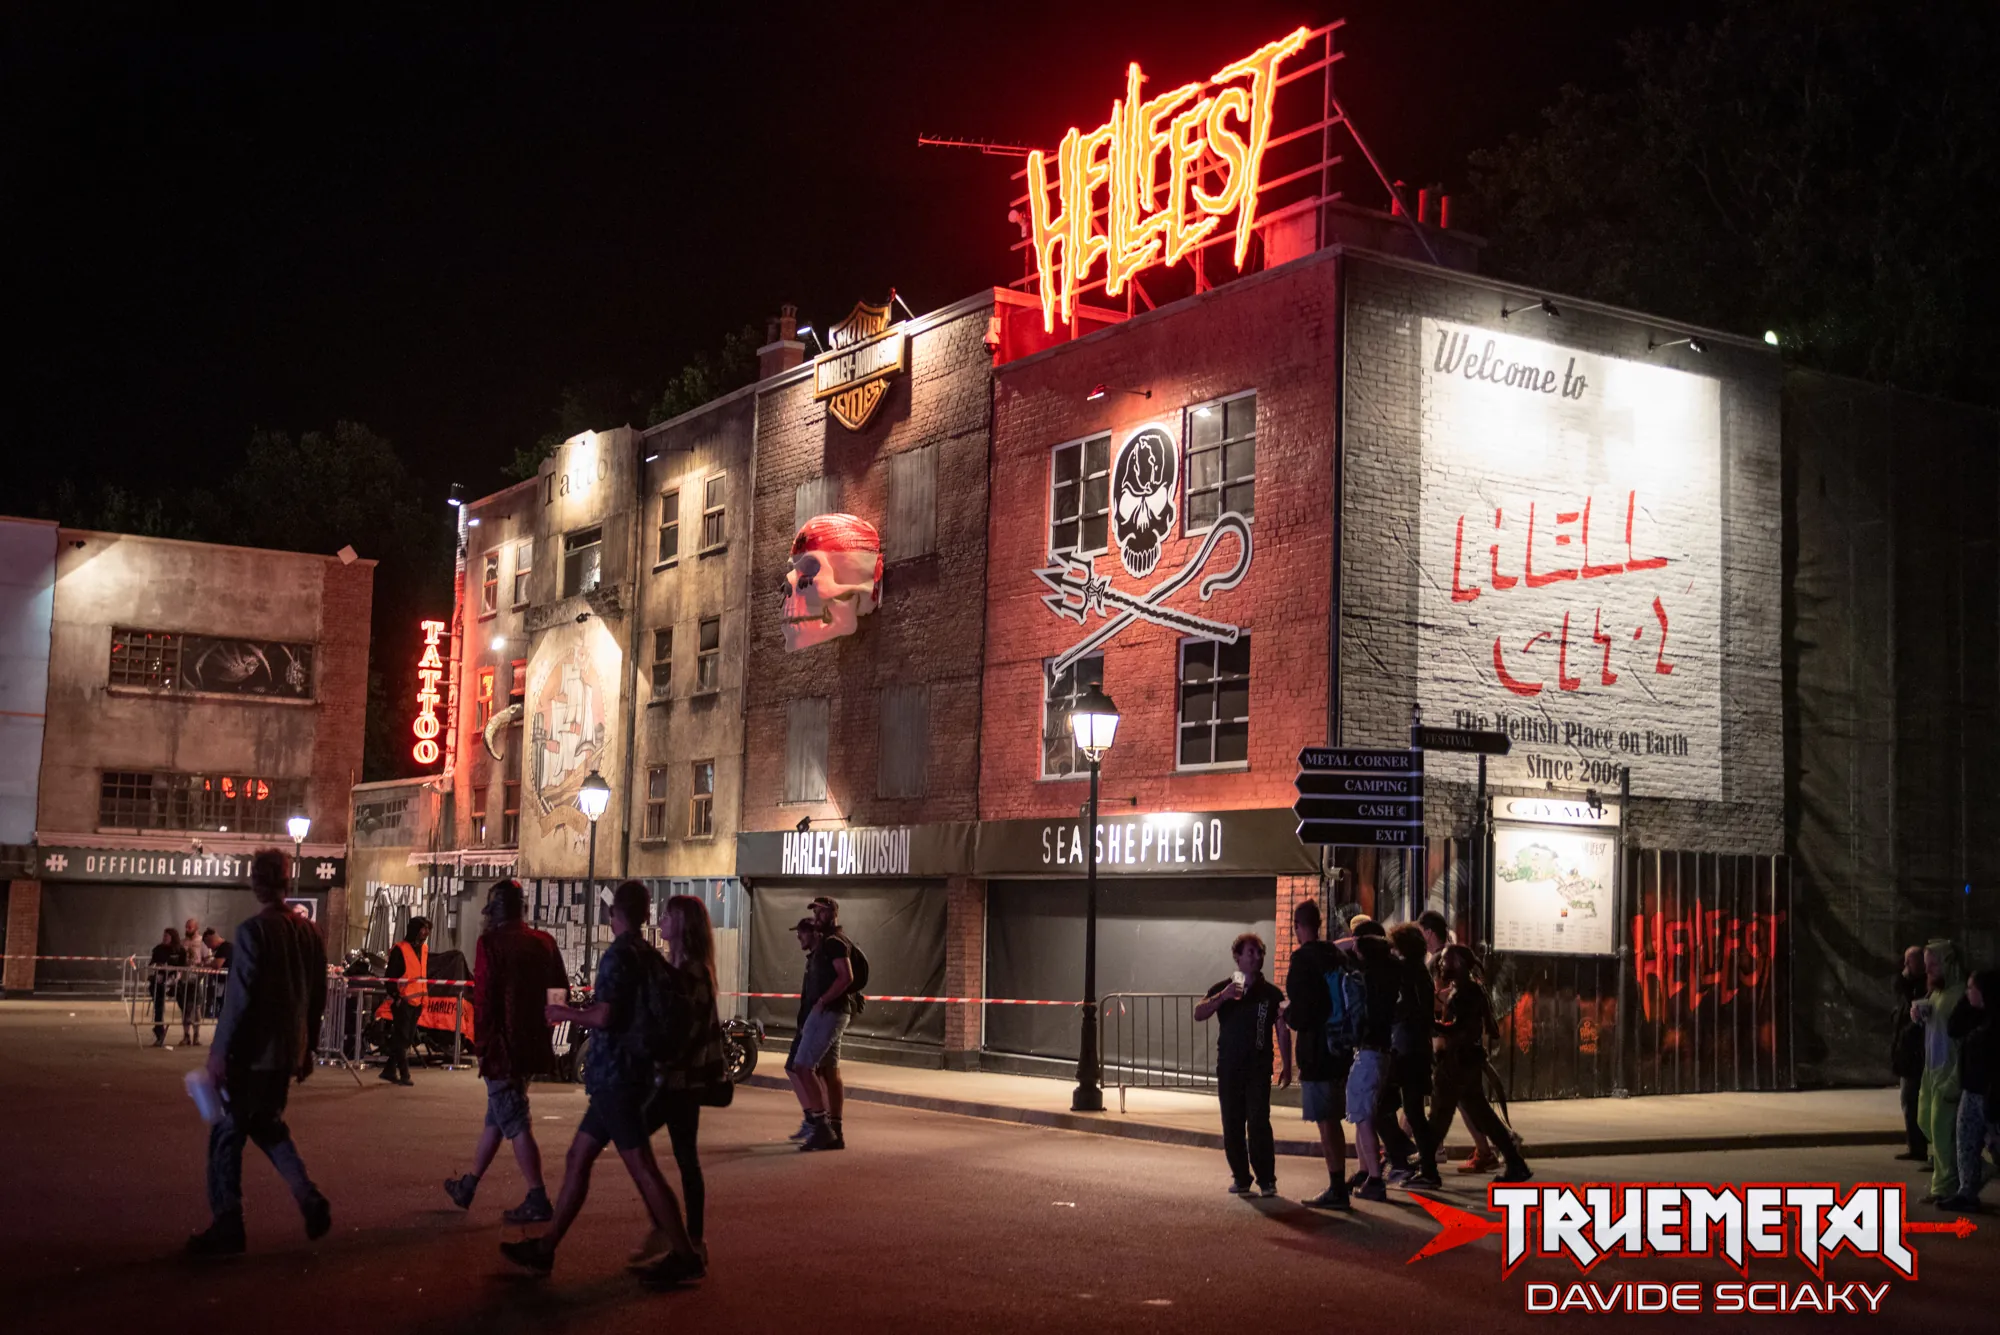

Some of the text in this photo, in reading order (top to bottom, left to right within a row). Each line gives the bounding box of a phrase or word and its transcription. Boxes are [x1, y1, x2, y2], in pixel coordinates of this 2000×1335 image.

[1027, 26, 1310, 333] HELLFEST
[818, 333, 900, 392] HARLEY-DAVIDS
[1433, 329, 1588, 400] Welcome to
[413, 619, 445, 764] TATTOO
[1425, 734, 1475, 748] FESTIVAL
[1495, 713, 1559, 744] Hellish
[1564, 720, 1614, 750] Place
[1619, 731, 1642, 756] on
[1645, 731, 1689, 756] Earth
[1305, 753, 1409, 768] METAL CORNER
[1527, 754, 1623, 786] Since 2006
[1344, 779, 1408, 793] CAMPING
[1357, 804, 1395, 818] CASH
[781, 829, 911, 875] HARLEY-DAVIDSON
[1042, 818, 1222, 865] SEA SHEPHERD
[1375, 829, 1407, 842] EXIT
[86, 855, 176, 876] OFFFICIAL
[182, 858, 240, 878] ARTIST
[1631, 897, 1787, 1025] HELLFEST
